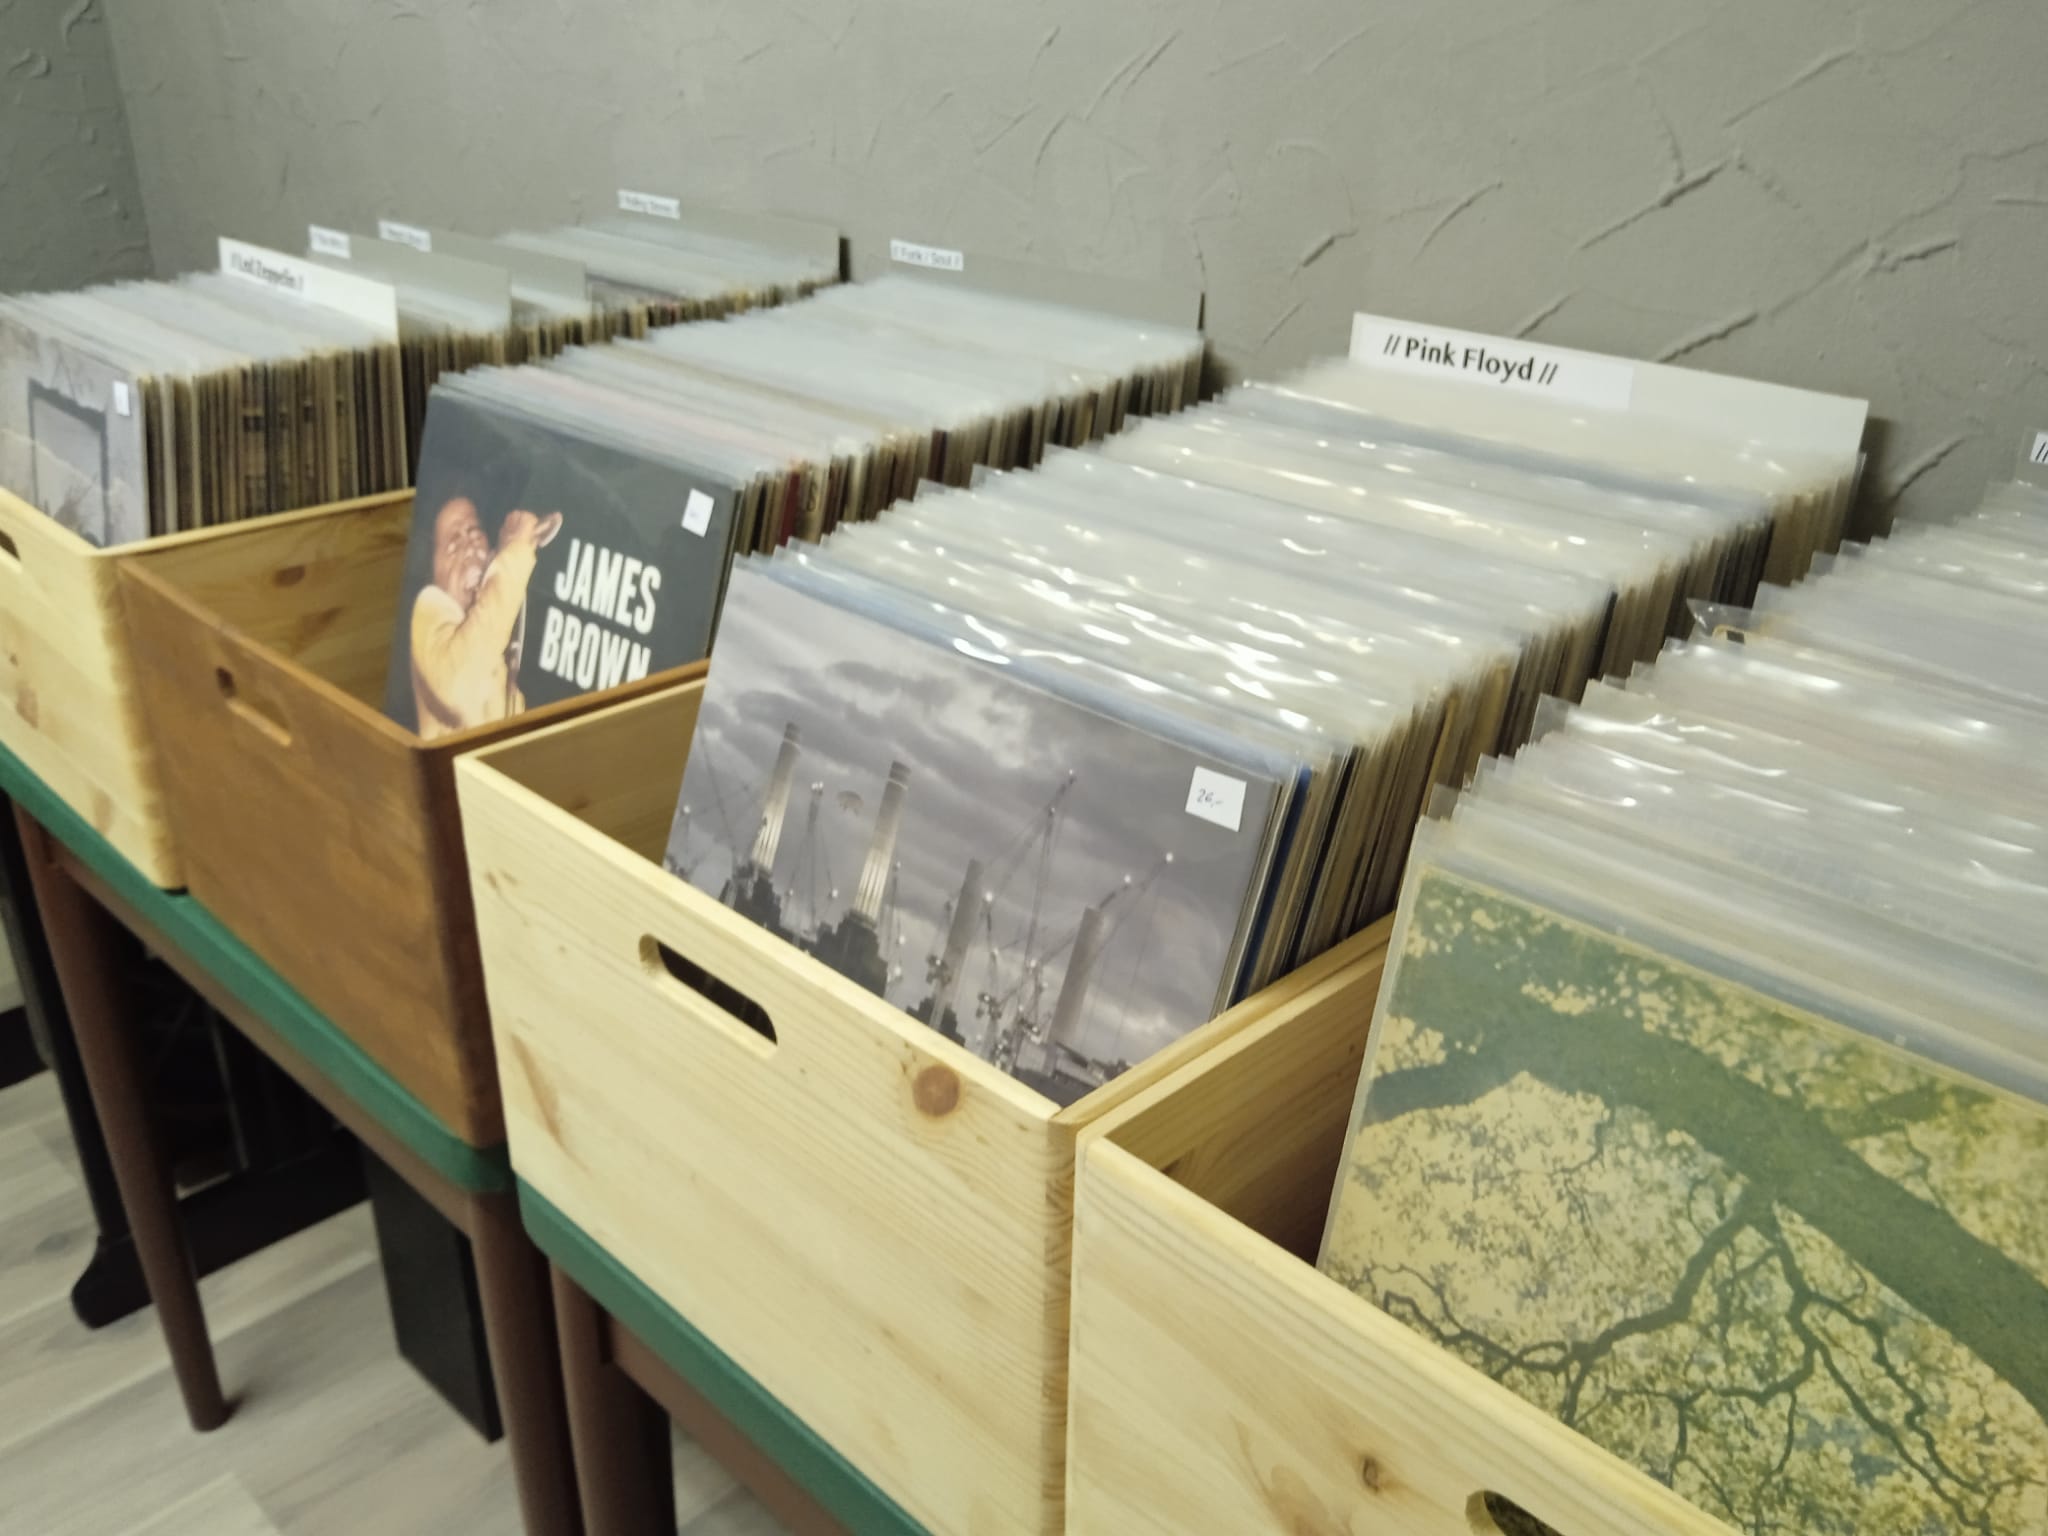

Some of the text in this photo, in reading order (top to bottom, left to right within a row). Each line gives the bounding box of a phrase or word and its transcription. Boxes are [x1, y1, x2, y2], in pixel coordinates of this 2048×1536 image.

[1405, 336, 1455, 367] Pink
[1463, 347, 1534, 383] Floyd
[554, 538, 662, 635] JAMES
[538, 605, 652, 691] BROWN
